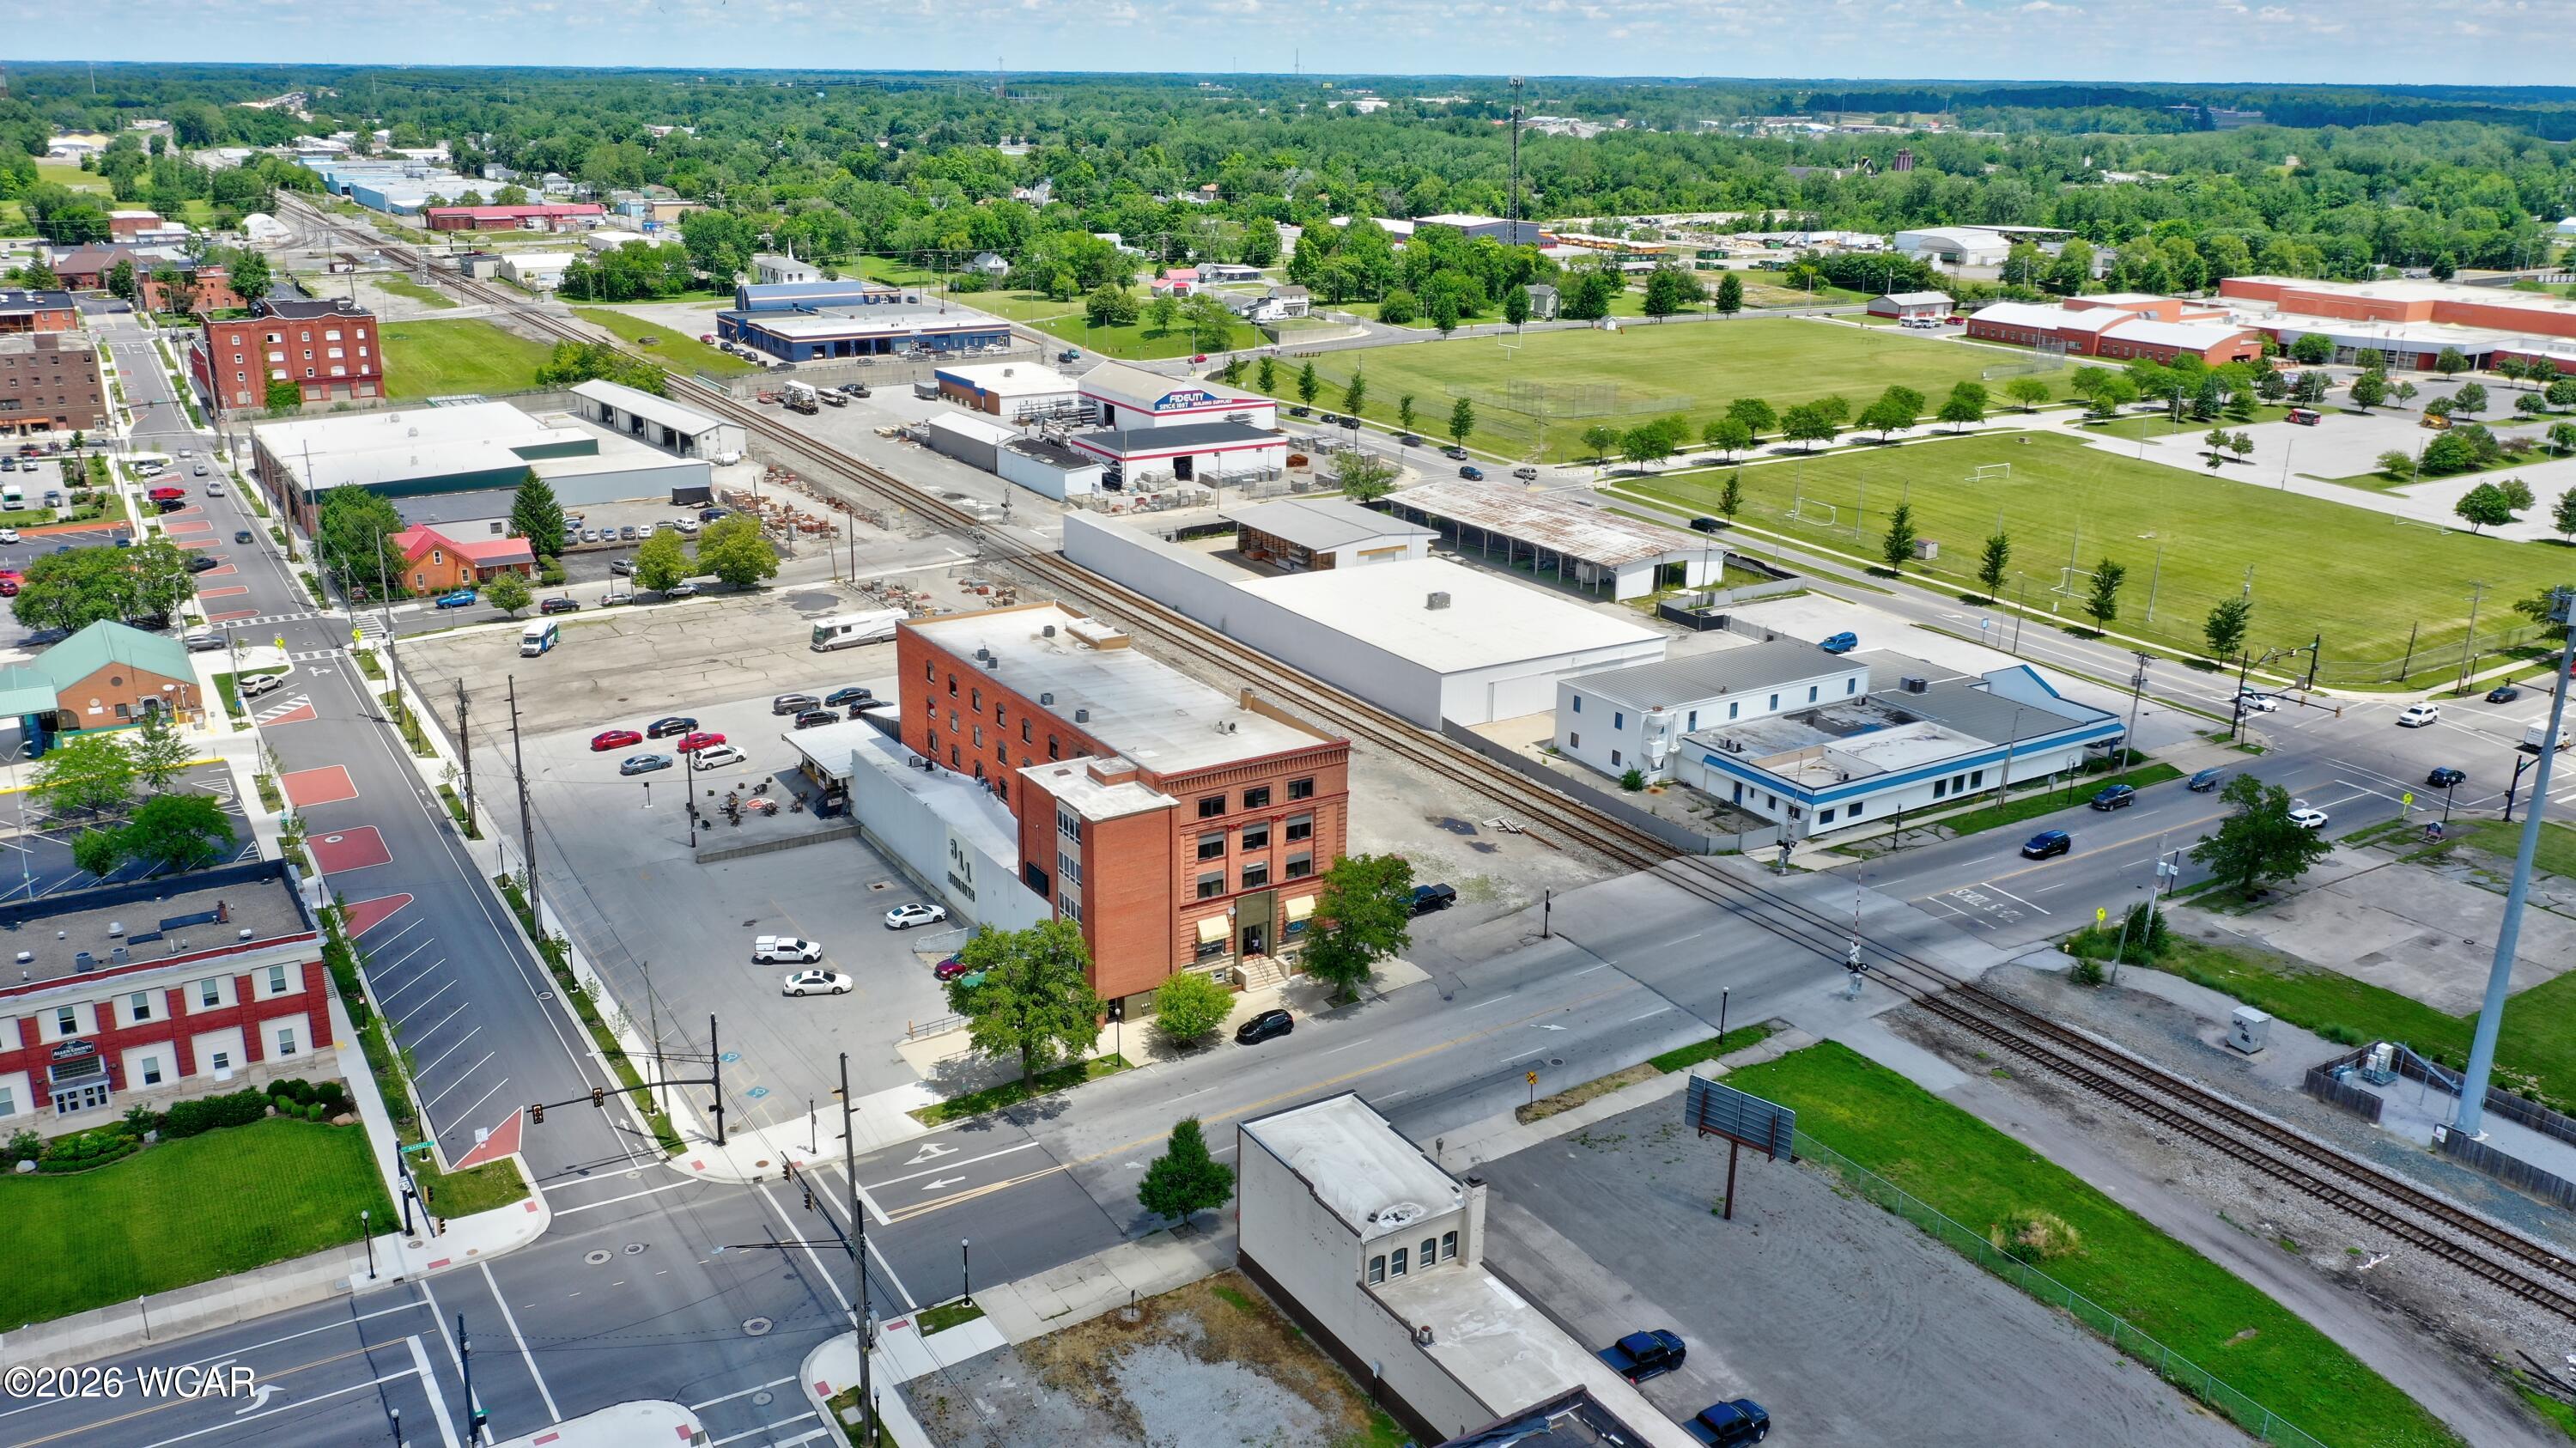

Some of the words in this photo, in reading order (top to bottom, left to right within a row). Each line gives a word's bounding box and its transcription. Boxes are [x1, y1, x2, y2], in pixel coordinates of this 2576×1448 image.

[1170, 392, 1204, 403] FIDELITY
[950, 838, 971, 883] 311
[947, 871, 975, 903] BUILDING
[408, 1142, 428, 1151] MARKET
